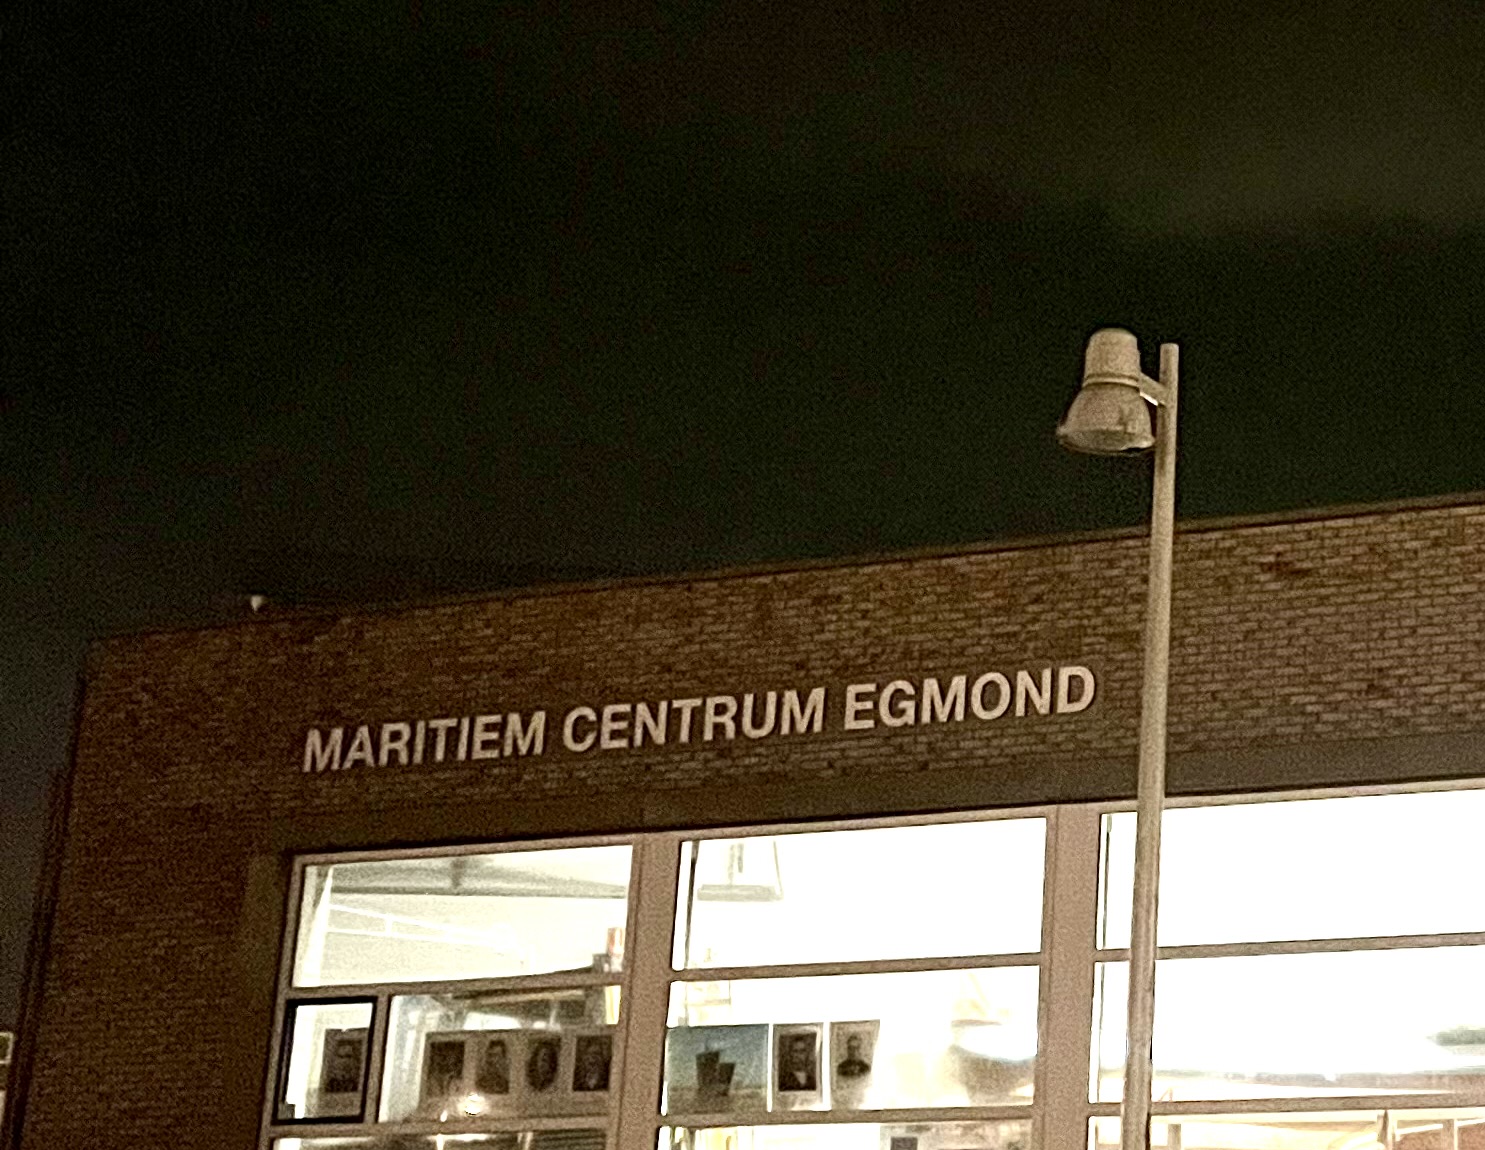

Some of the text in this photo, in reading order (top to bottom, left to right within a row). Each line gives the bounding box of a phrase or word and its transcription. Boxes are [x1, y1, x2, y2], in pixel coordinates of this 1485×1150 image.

[302, 665, 1096, 773] MARITIEM CENTRUM EGMOND
